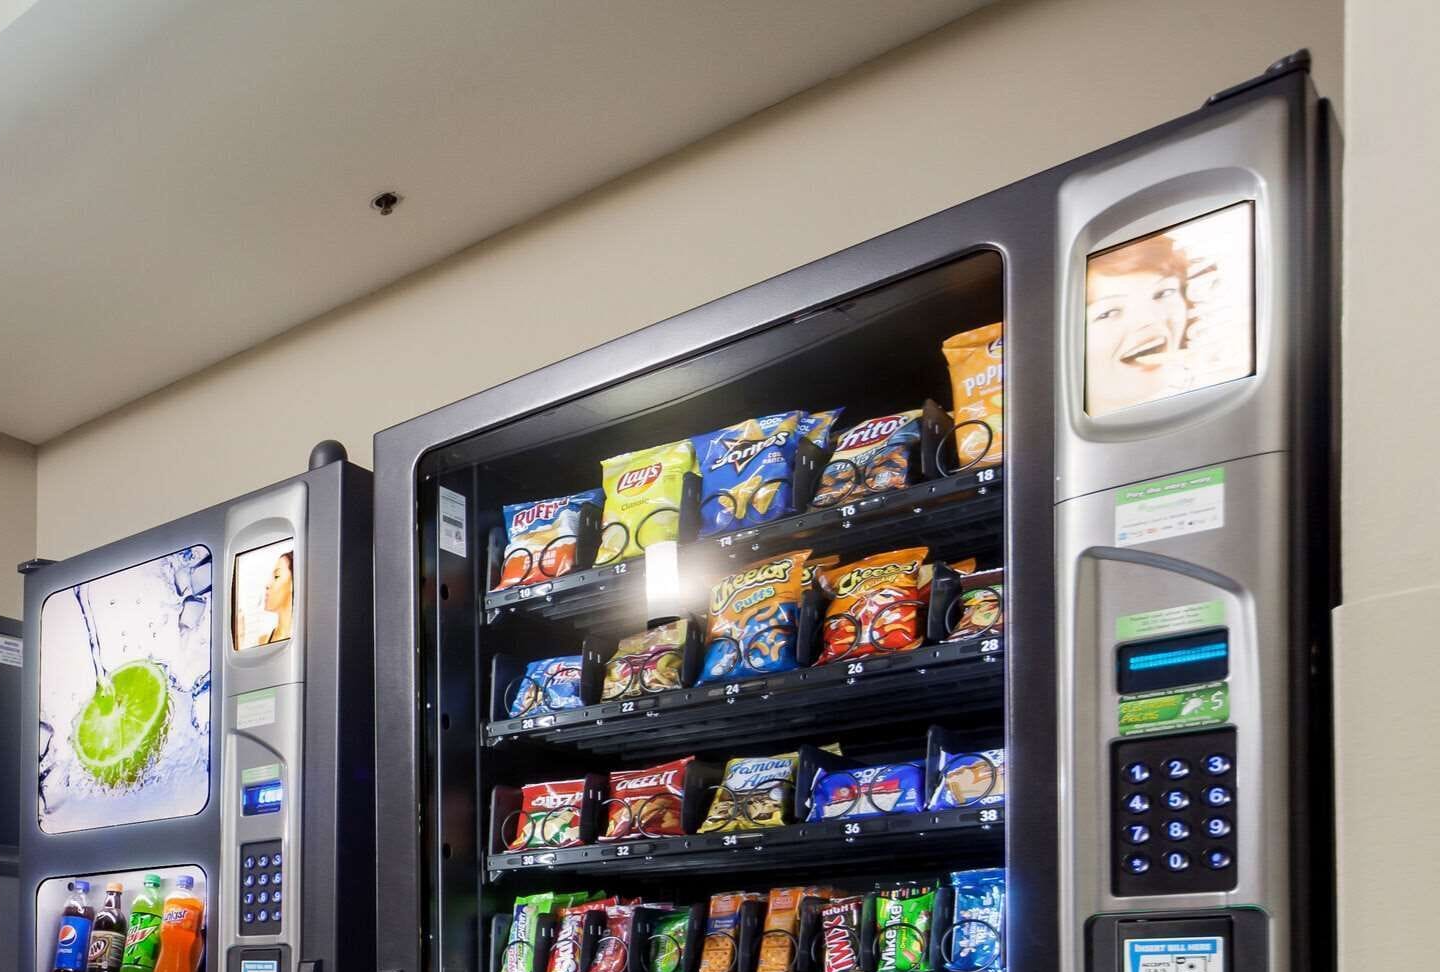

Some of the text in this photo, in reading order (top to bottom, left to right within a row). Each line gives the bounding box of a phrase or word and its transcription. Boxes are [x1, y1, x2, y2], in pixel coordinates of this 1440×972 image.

[712, 432, 789, 470] Doritos
[976, 469, 994, 482] 18
[513, 498, 570, 531] RUFF
[841, 505, 855, 517] 16
[615, 564, 627, 574] 12
[981, 639, 999, 652] 28
[848, 664, 863, 674] 26
[726, 684, 739, 695] 24
[622, 702, 634, 712] 22
[522, 719, 534, 729] 20
[729, 758, 792, 775] Famous
[1131, 757, 1222, 779] 1 2 3
[1129, 788, 1224, 809] 4 5 6
[980, 810, 997, 821] 38
[845, 824, 860, 834] 36
[1131, 820, 1224, 840] 7 8 9
[723, 835, 737, 846] 34
[617, 846, 629, 855] 32
[523, 856, 534, 865] 30
[1169, 854, 1181, 868] 0
[880, 930, 897, 970] Mike
